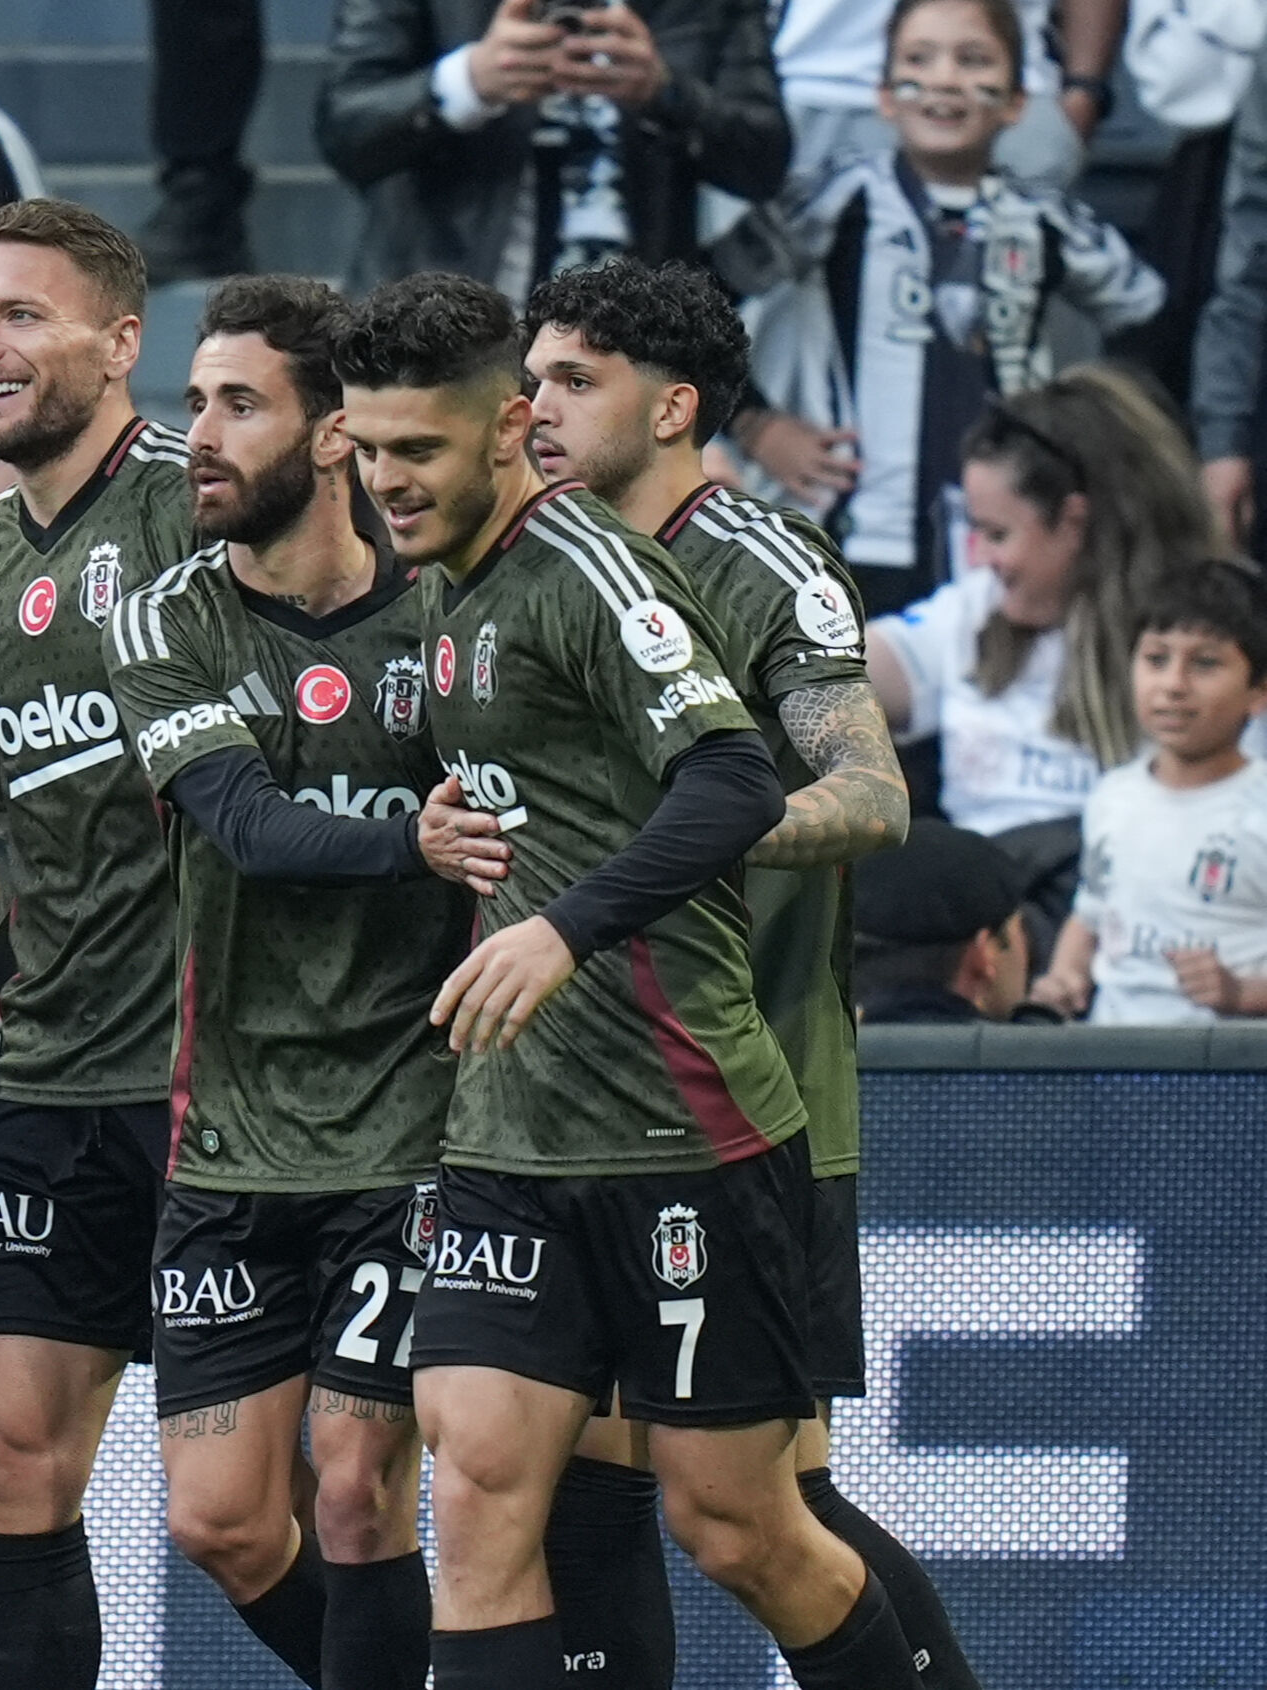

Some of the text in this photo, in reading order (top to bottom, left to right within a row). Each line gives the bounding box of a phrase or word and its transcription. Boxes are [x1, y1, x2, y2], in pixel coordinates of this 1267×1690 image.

[433, 1229, 548, 1284] BAU
[159, 1259, 256, 1315] BAU
[485, 1281, 538, 1302] University
[658, 1297, 706, 1399] 7
